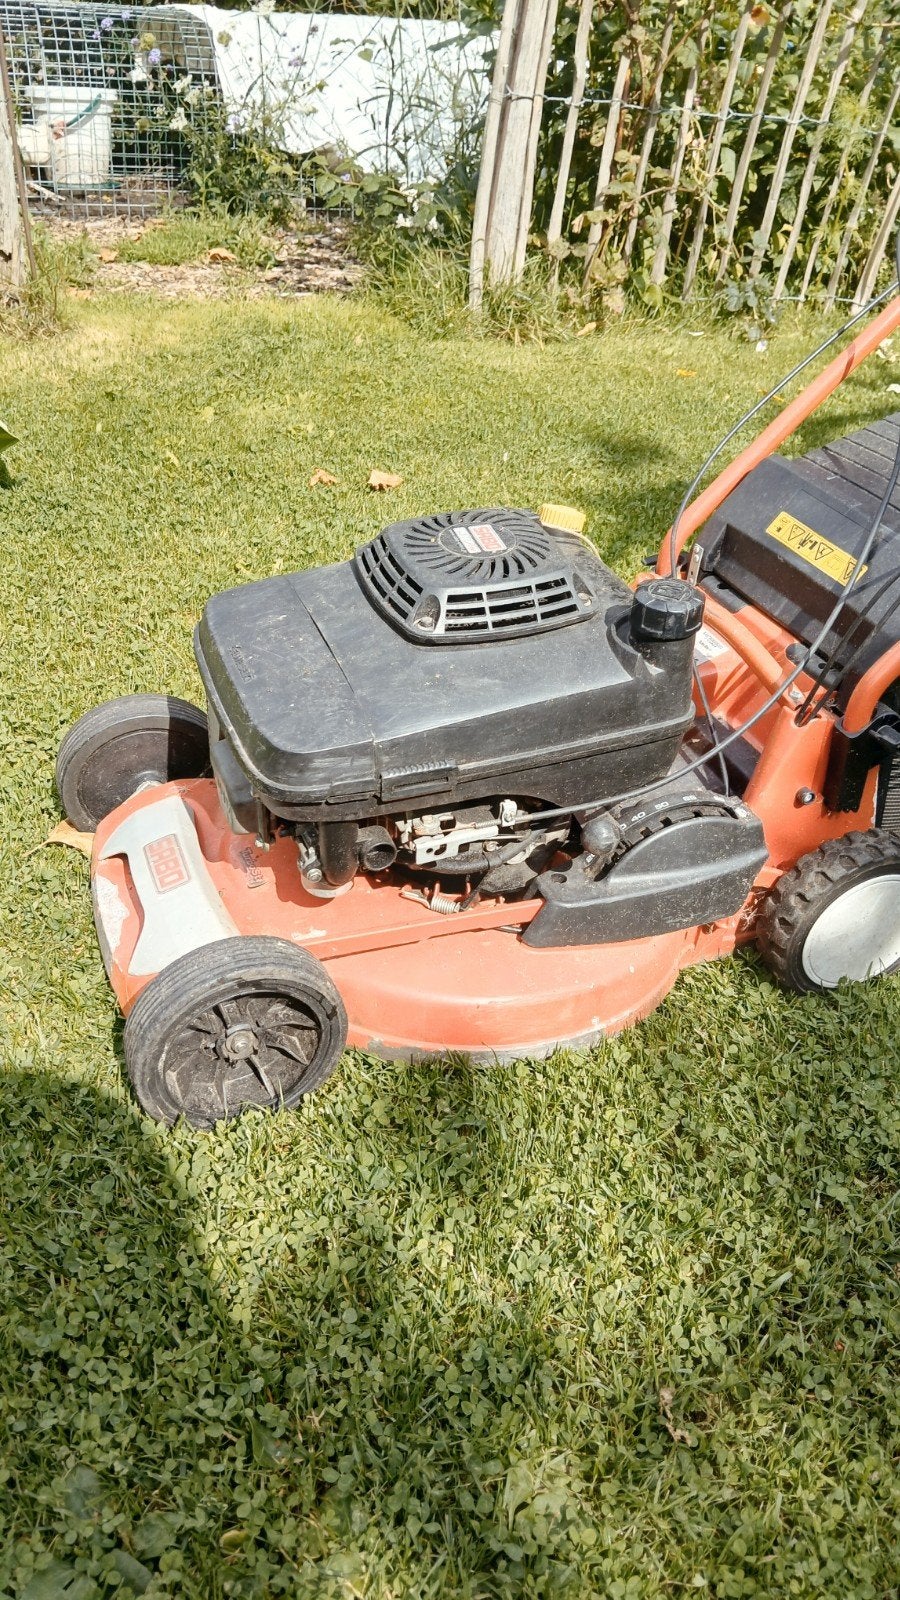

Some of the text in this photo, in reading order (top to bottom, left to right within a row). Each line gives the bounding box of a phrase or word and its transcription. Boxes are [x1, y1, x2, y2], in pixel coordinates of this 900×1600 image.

[631, 811, 646, 822] 40
[146, 836, 187, 890] SABO
[240, 846, 265, 884] TurboSt
